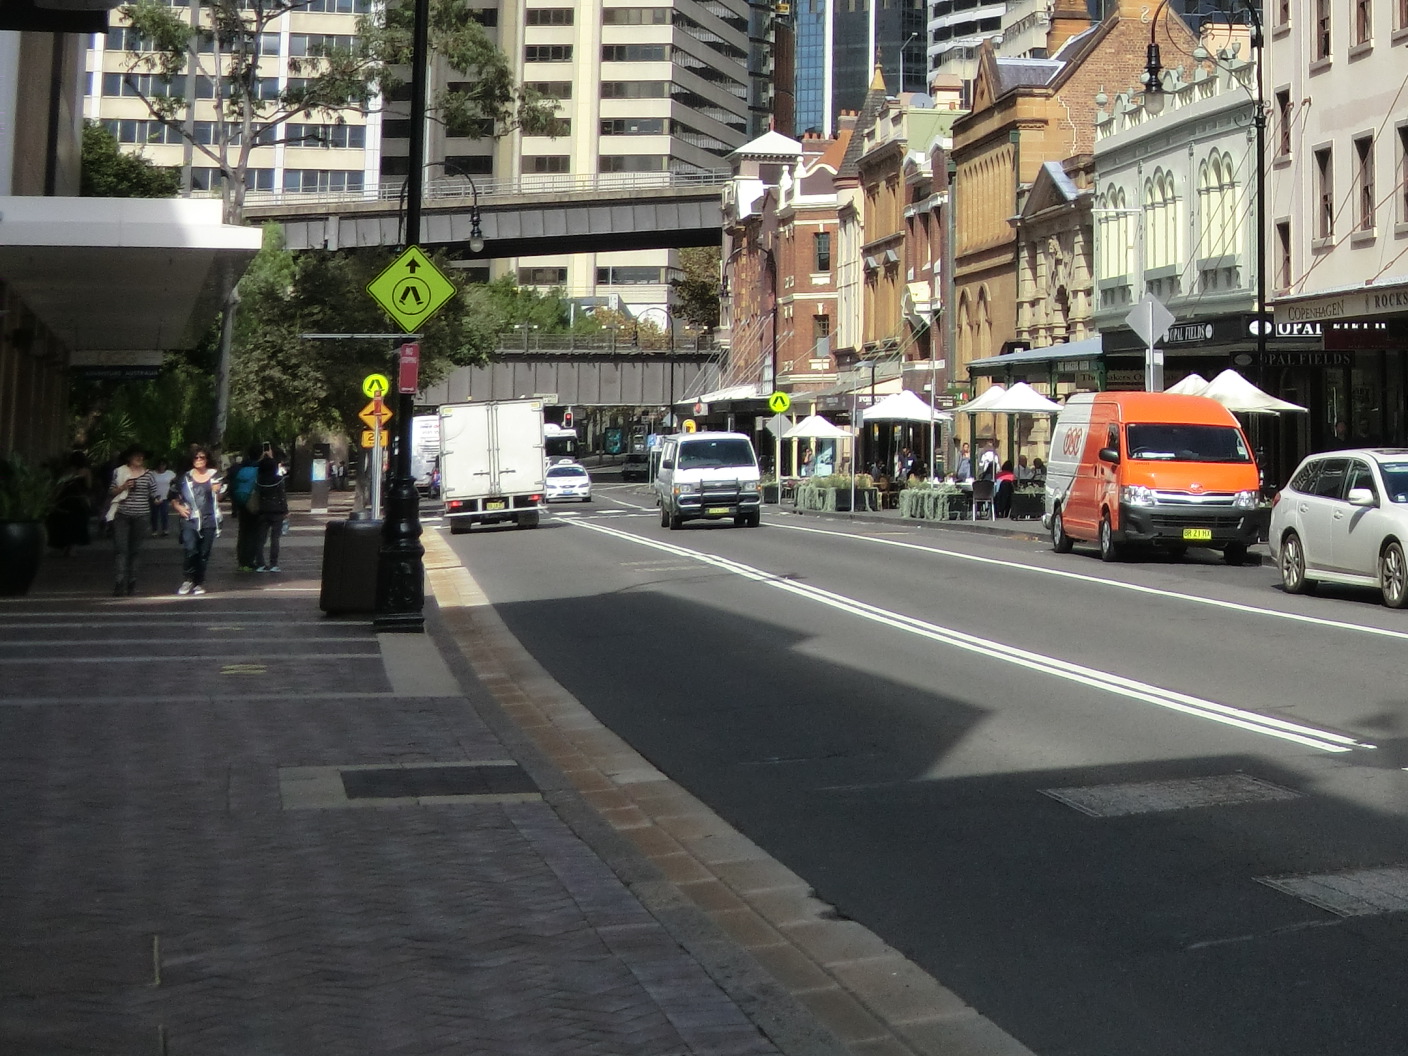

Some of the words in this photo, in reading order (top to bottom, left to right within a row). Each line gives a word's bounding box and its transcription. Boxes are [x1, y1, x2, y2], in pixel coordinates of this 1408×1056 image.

[1374, 290, 1408, 309] ROCKS
[1288, 299, 1345, 321] COPENHAGEN
[1169, 326, 1184, 341] OPAL
[1184, 324, 1205, 340] FIELDS
[1261, 353, 1296, 365] PAL
[1299, 353, 1351, 365] FIELDS
[1106, 373, 1131, 381] akers
